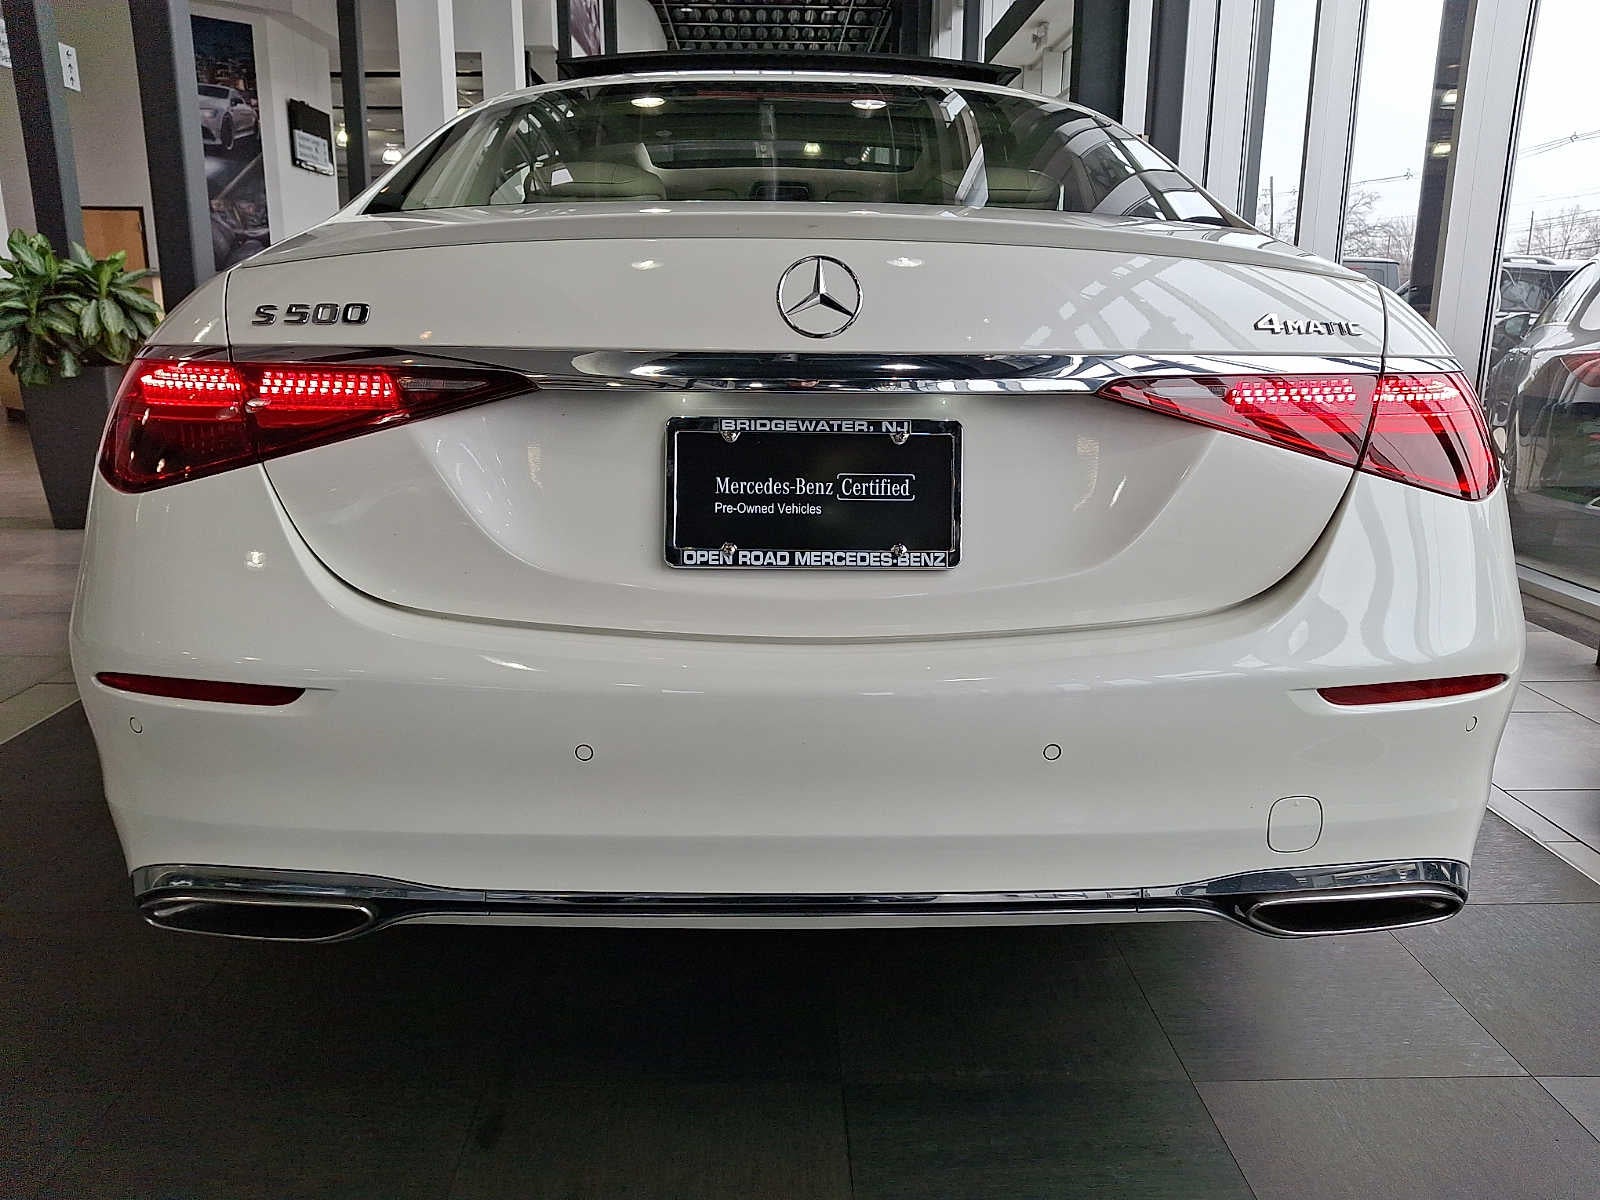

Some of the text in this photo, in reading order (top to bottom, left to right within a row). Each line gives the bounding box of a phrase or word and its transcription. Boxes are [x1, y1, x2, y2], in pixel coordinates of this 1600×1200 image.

[251, 303, 370, 326] S 500
[1253, 312, 1363, 336] 4MATIC
[721, 419, 909, 433] BRIDGEWATER, NJ
[715, 476, 911, 496] Mercedes-Benz Certified
[714, 502, 822, 515] Pre-Owned Vehicles
[683, 550, 733, 565] OPEN
[738, 551, 790, 566] ROAD
